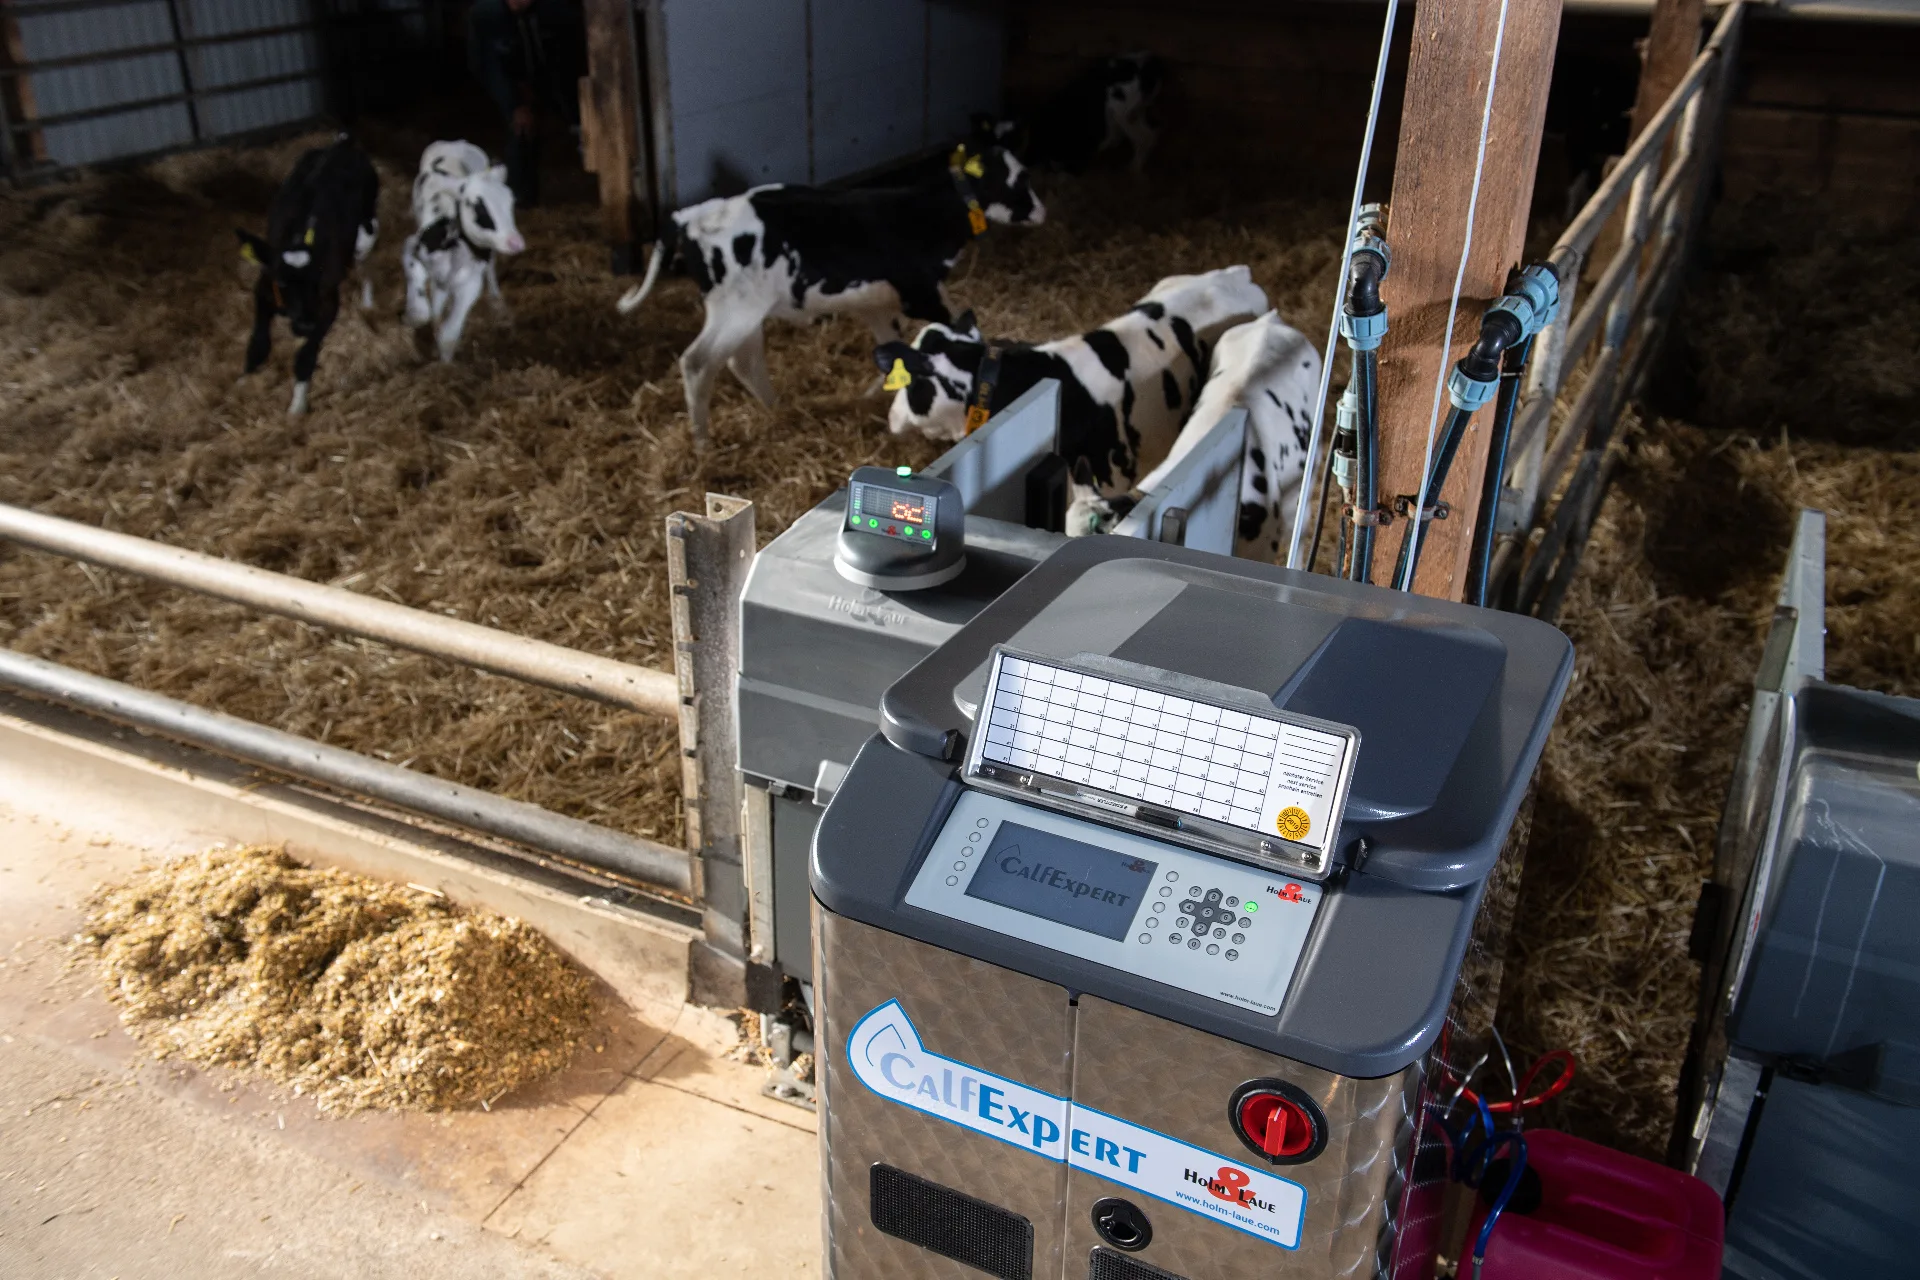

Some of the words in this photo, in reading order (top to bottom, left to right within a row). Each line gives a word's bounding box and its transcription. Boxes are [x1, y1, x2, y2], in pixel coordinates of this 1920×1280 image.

[1286, 818, 1299, 830] 2019
[1266, 885, 1288, 898] Holm
[1292, 893, 1312, 904] Laue
[1184, 1168, 1225, 1194] Holm
[1238, 1189, 1276, 1213] Laue
[1175, 1190, 1280, 1235] www.holm-laue.com
